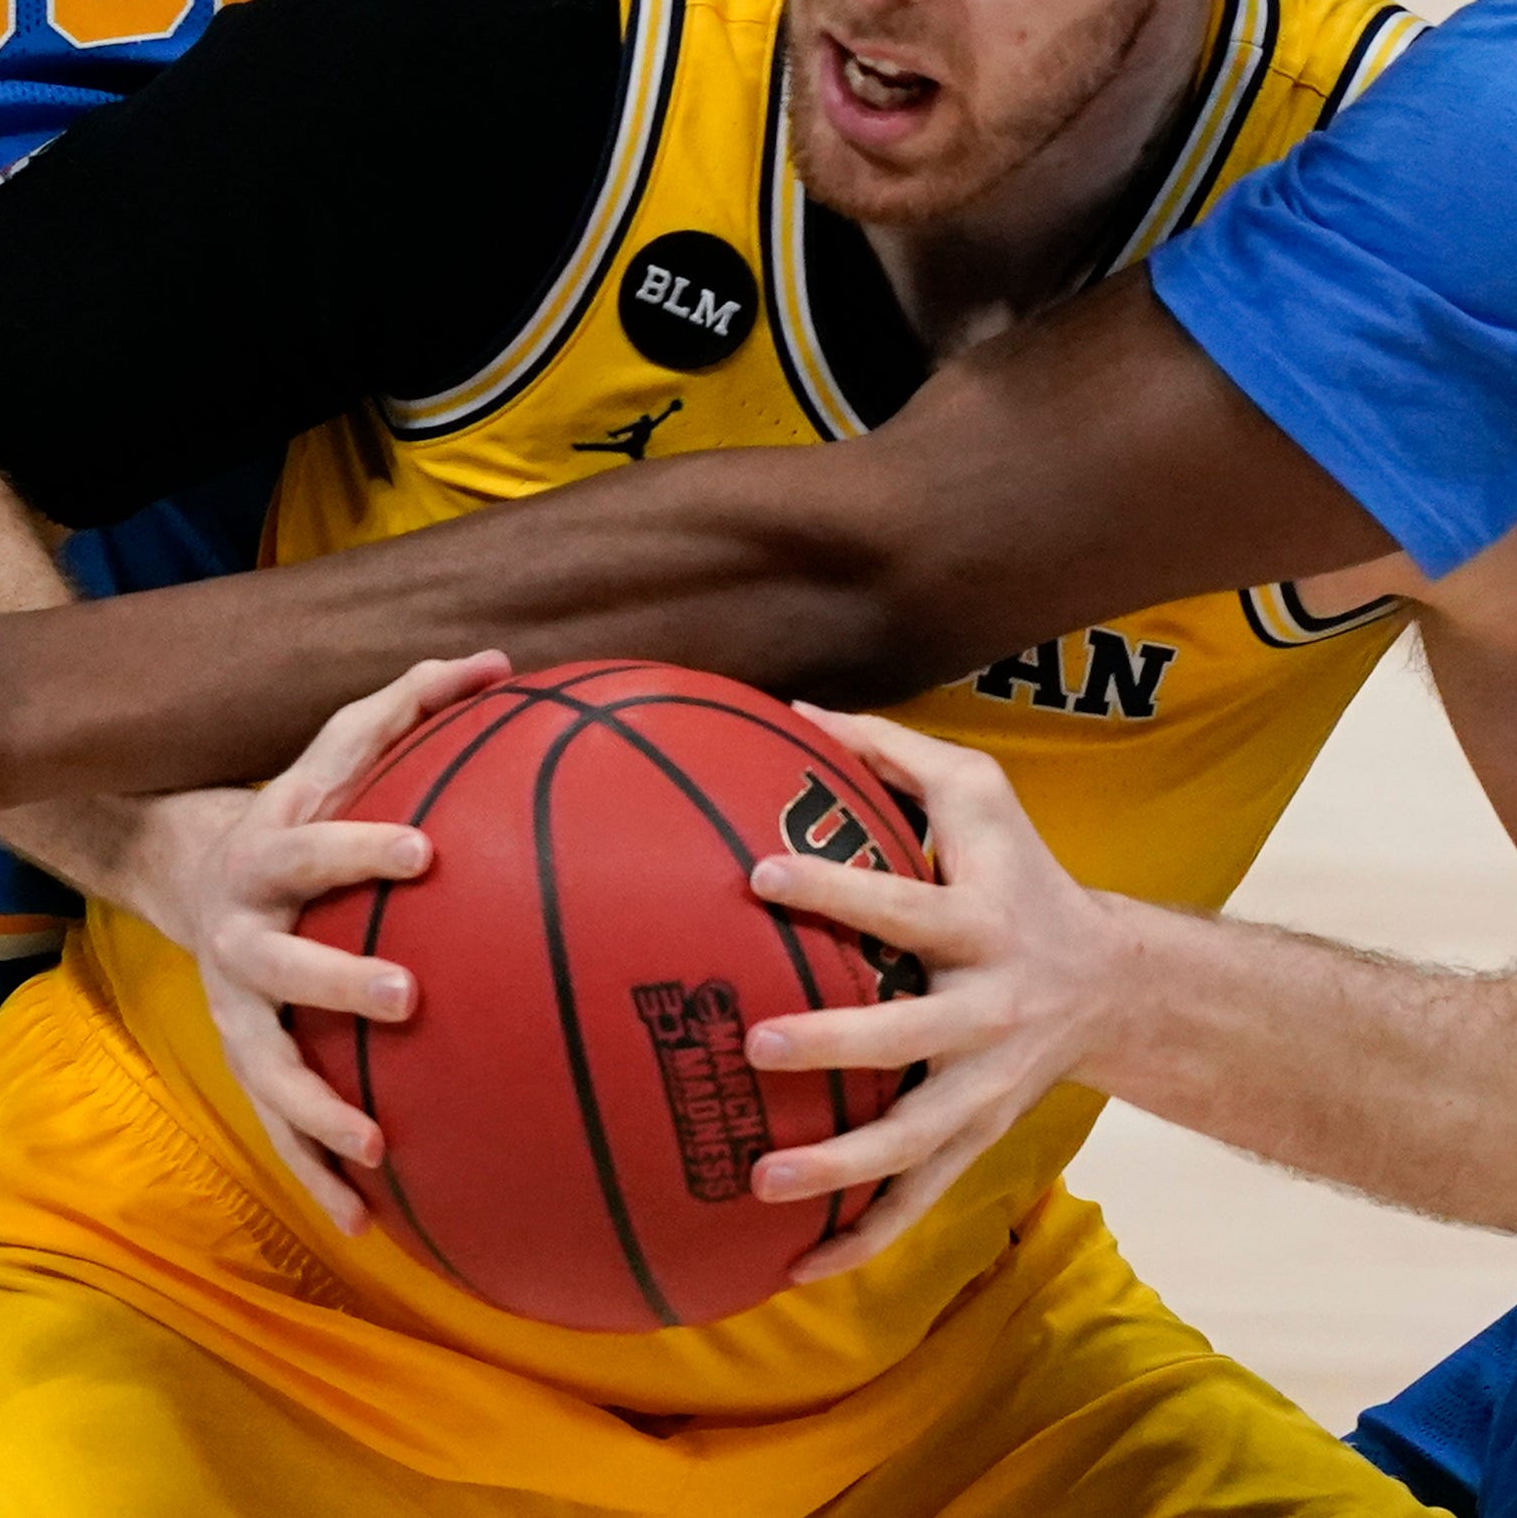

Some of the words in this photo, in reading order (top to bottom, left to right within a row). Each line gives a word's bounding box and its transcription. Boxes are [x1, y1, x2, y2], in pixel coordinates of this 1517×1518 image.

[635, 263, 743, 337] BLM
[671, 1045, 736, 1200] MADNESS
[704, 1020, 765, 1139] MARCH
